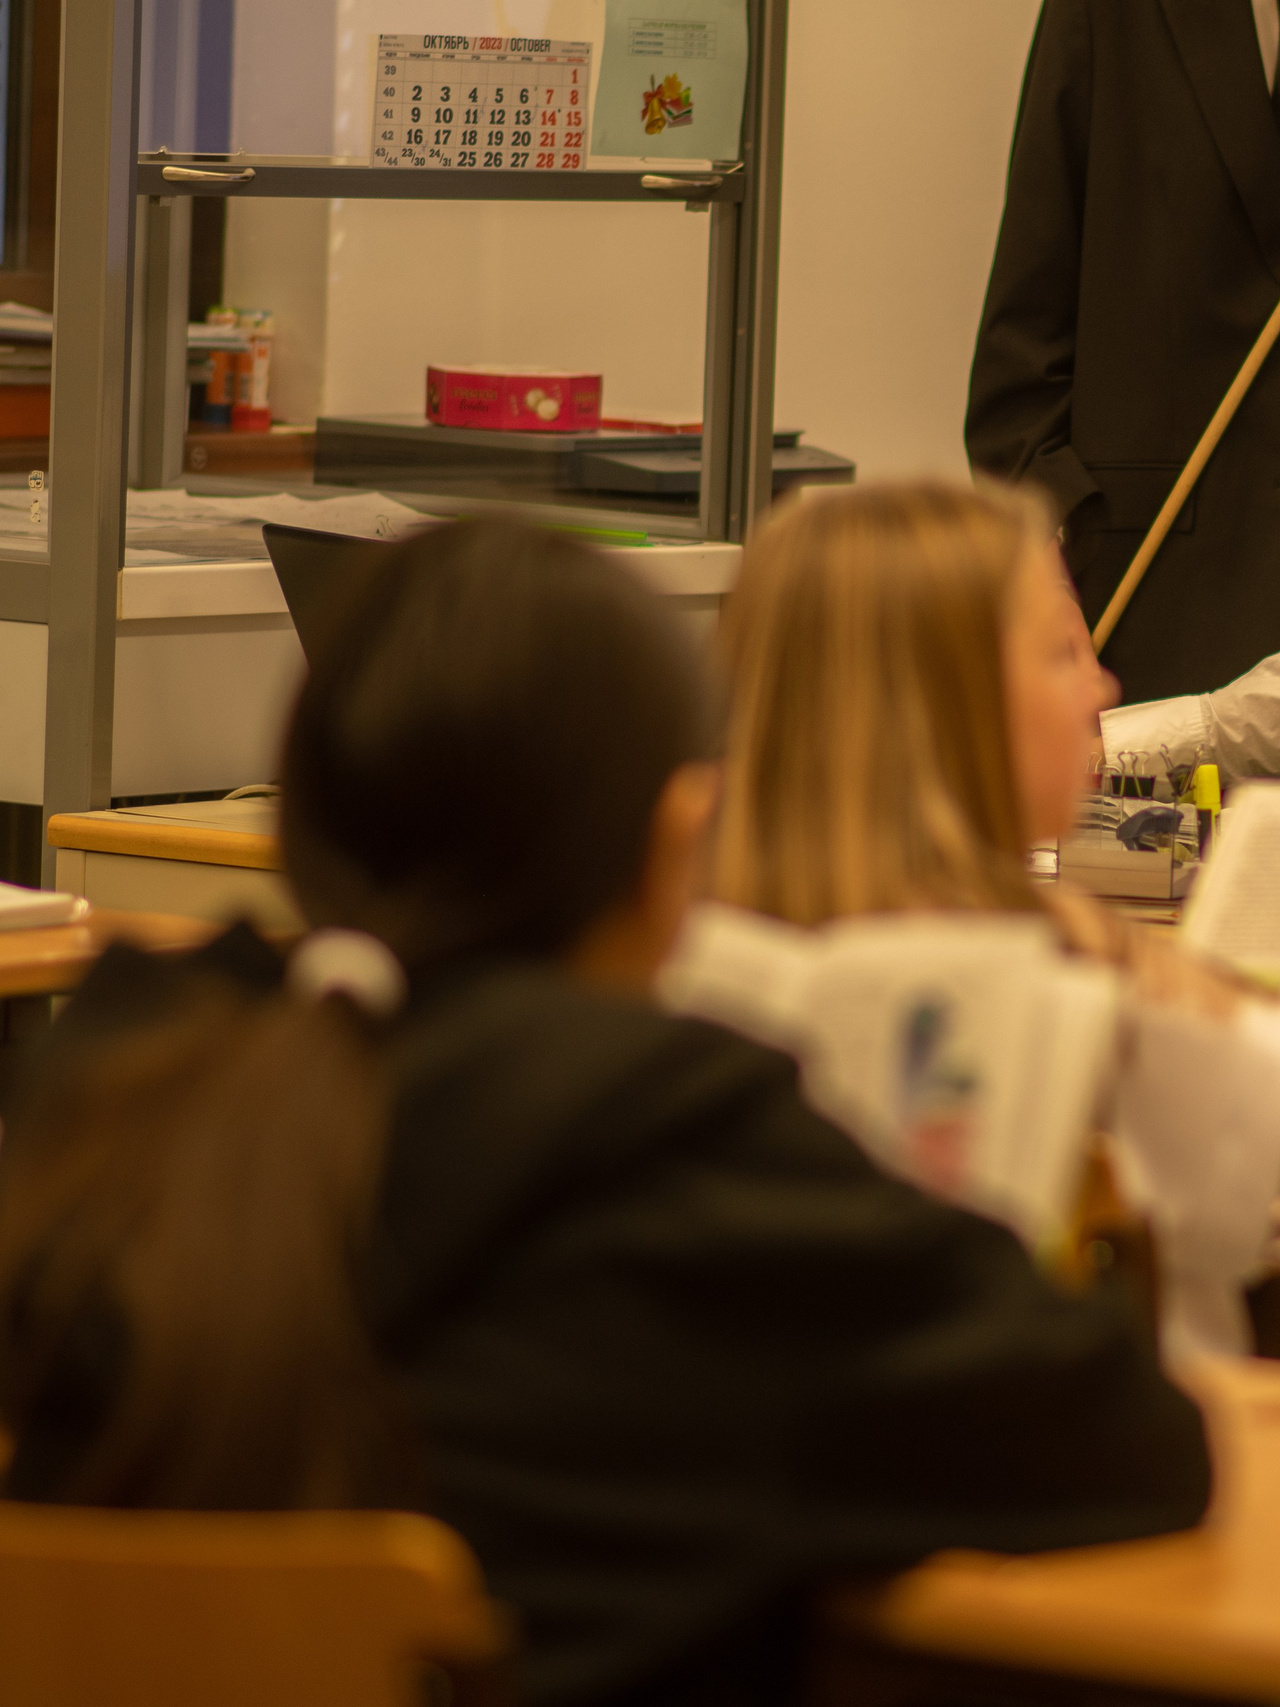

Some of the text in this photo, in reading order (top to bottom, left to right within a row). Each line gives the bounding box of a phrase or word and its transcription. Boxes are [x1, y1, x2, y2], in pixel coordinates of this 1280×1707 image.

[423, 34, 470, 50] ОКТЯБРЬ
[479, 37, 502, 50] 2023
[510, 38, 551, 52] OCTOBER
[384, 65, 578, 84] 39 1
[383, 85, 578, 105] 40 2 3 4 5 6 7 8
[383, 107, 582, 126] 41 9 10 11 12 13 14 15
[382, 129, 582, 147] 42 16 17 18 19 20 21 22
[457, 151, 477, 167] 25
[483, 152, 503, 167] 26
[510, 152, 529, 167] 27
[536, 152, 555, 168] 28
[561, 153, 580, 169] 29
